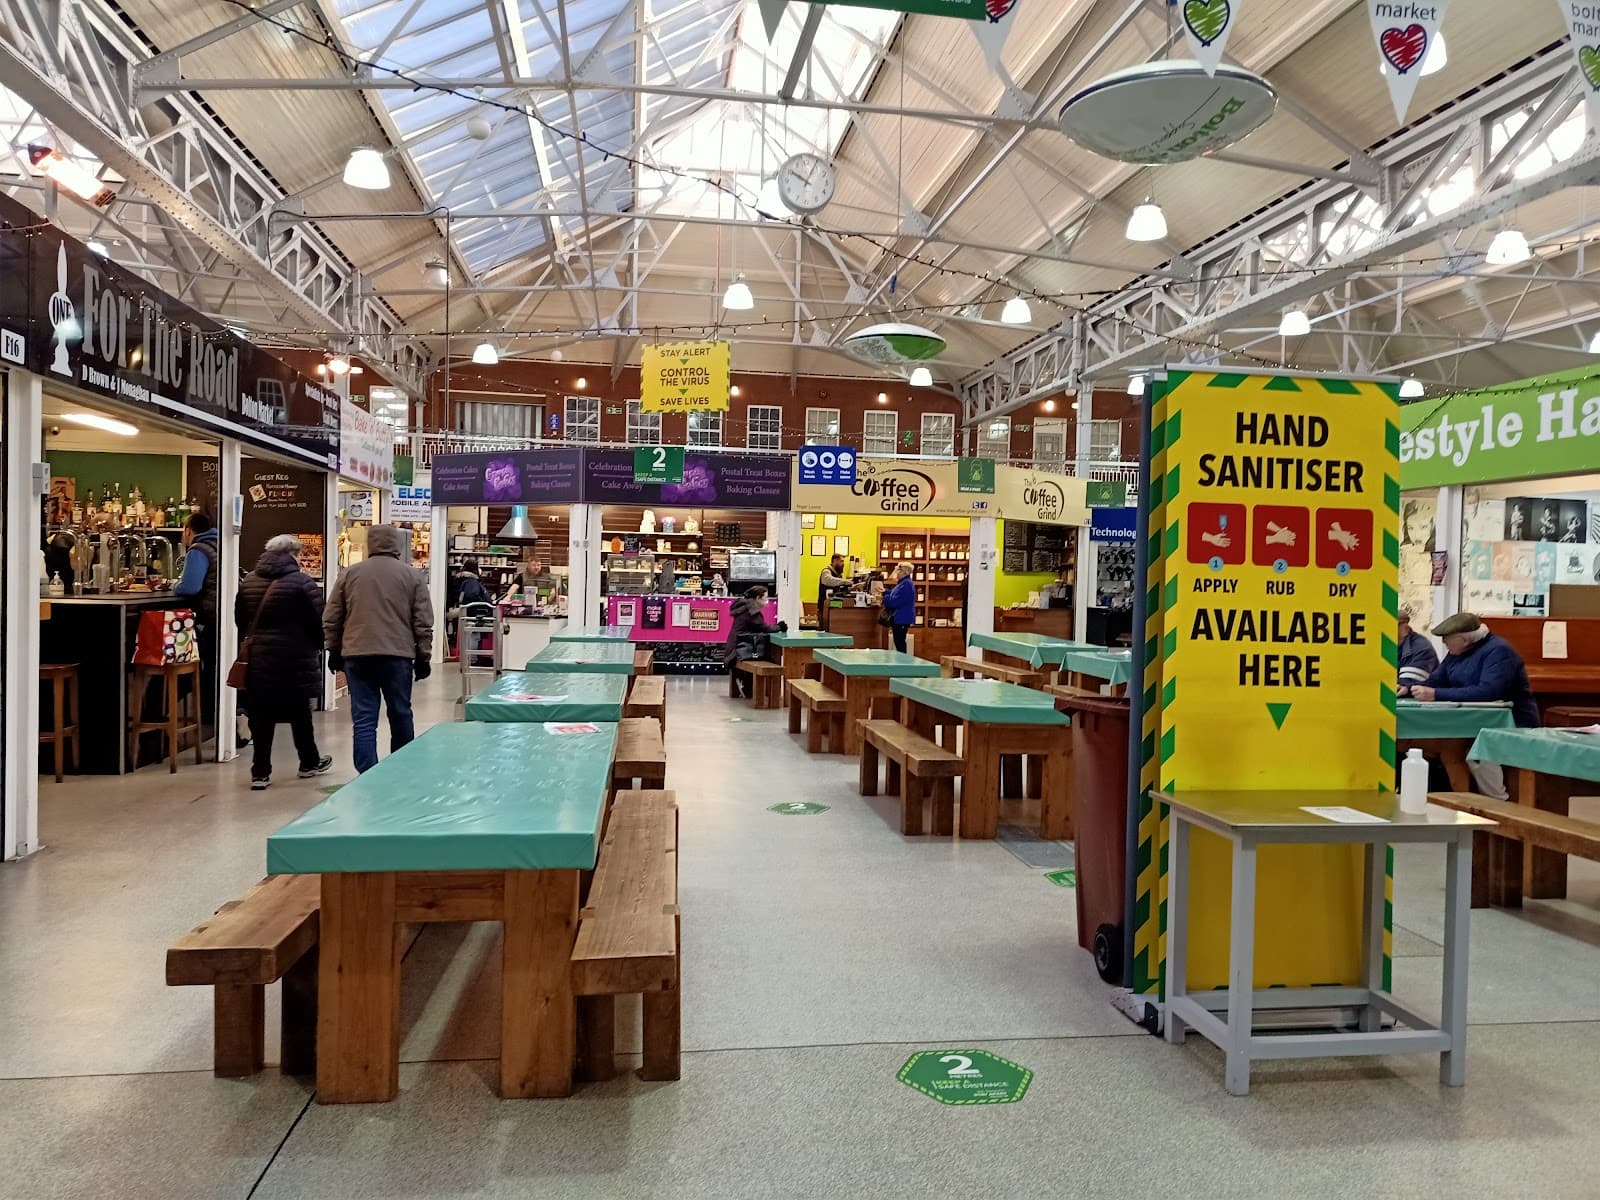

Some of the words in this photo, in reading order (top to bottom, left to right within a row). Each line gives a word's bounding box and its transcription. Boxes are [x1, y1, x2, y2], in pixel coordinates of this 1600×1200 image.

[1376, 1, 1437, 21] market
[52, 295, 72, 326] ONE
[5, 335, 20, 358] F16
[81, 263, 131, 369] For
[140, 294, 183, 389] The
[189, 321, 239, 412] Road
[660, 349, 680, 357] STAY
[682, 347, 711, 356] ALERT
[660, 367, 710, 377] CONTROL
[660, 377, 678, 387] THE
[681, 376, 710, 386] VIRUS
[82, 363, 88, 381] D
[88, 366, 110, 390] Brown
[109, 375, 116, 391] &
[120, 378, 150, 402] Monaghan
[660, 397, 683, 406] SAVE
[684, 396, 710, 405] LIVES
[1536, 387, 1600, 442] Ha
[1235, 411, 1329, 448] HAND
[588, 462, 633, 472] Celebration
[652, 447, 666, 468] 2
[435, 466, 463, 475] Celebration
[721, 467, 743, 477] Postal
[744, 467, 763, 477] Treat
[765, 468, 787, 478] Boxes
[856, 466, 868, 477] he
[1198, 453, 1364, 493] SANITISER
[601, 480, 621, 490] Cake
[622, 480, 645, 493] Away
[726, 485, 752, 496] Baking
[753, 485, 780, 495] Classes
[851, 478, 920, 498] Coffee
[880, 498, 919, 512] Grind
[1023, 487, 1057, 508] Coffee
[1037, 508, 1057, 521] Grind
[1091, 526, 1137, 539] Technolog
[1213, 560, 1218, 568] 1
[1277, 562, 1283, 570] 2
[1340, 565, 1346, 573] 3
[1192, 578, 1238, 593] APPLY
[1266, 580, 1295, 595] RUB
[1328, 582, 1357, 598] DRY
[1190, 608, 1366, 645] AVAILABLE
[1239, 653, 1321, 687] HERE
[938, 1054, 981, 1075] 2
